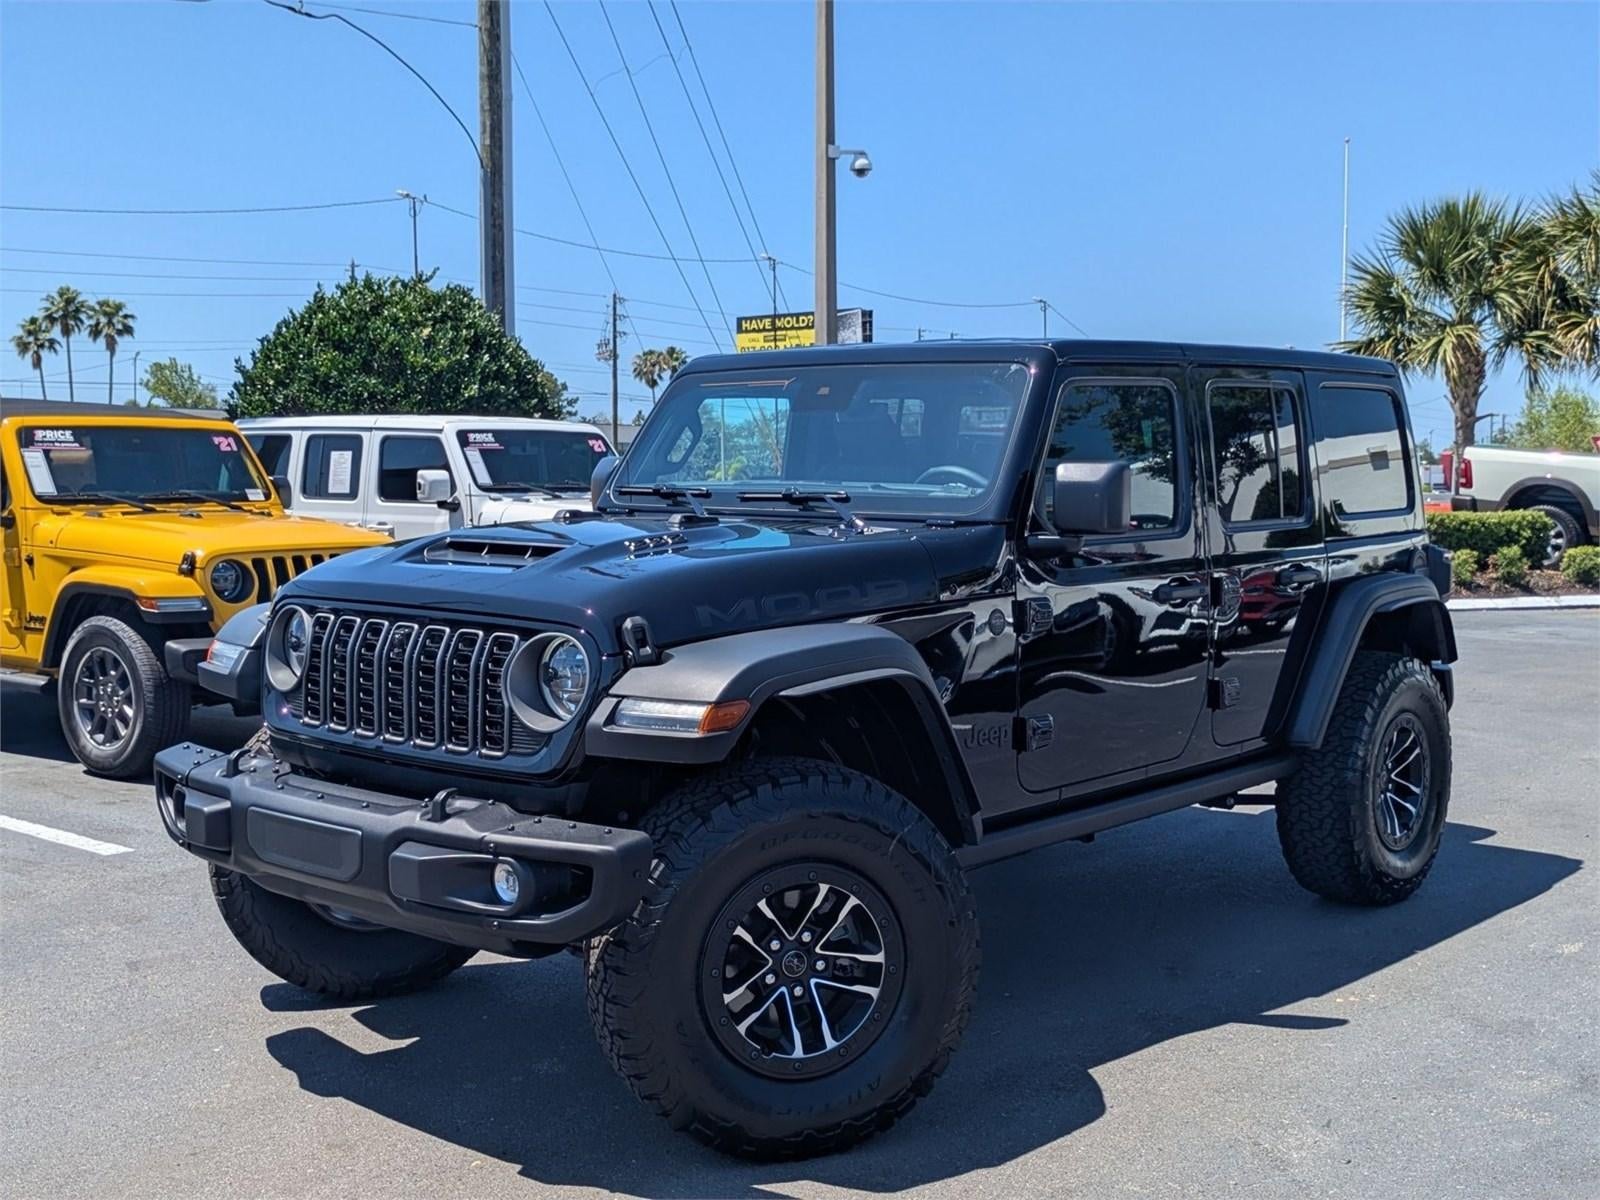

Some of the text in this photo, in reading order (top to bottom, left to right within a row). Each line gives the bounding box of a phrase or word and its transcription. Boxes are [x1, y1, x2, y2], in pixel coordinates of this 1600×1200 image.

[742, 315, 814, 331] HAVE MOLD?
[964, 722, 1009, 750] Jeep
